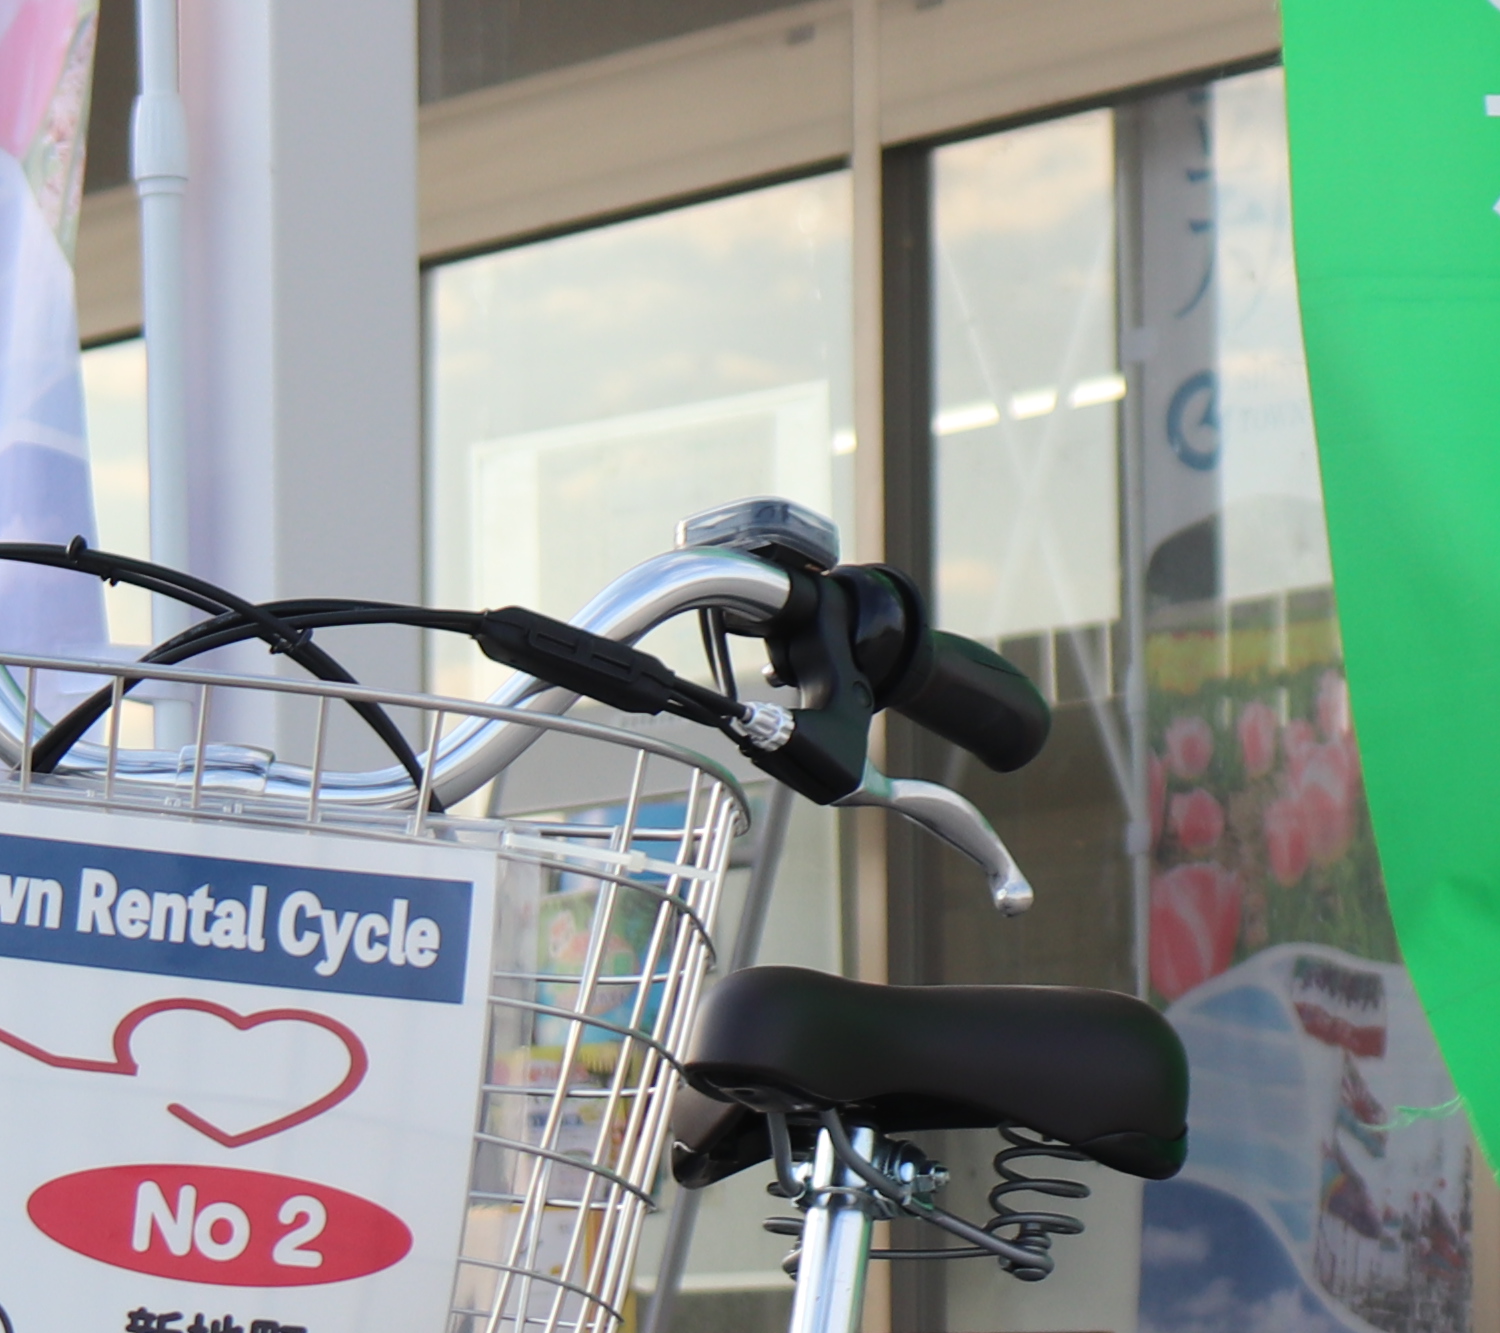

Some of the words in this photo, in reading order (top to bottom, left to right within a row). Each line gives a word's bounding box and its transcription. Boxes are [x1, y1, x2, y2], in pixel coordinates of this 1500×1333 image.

[77, 868, 266, 953] Rental
[279, 891, 440, 976] Cycle
[131, 1180, 250, 1262] No
[272, 1195, 328, 1268] 2
